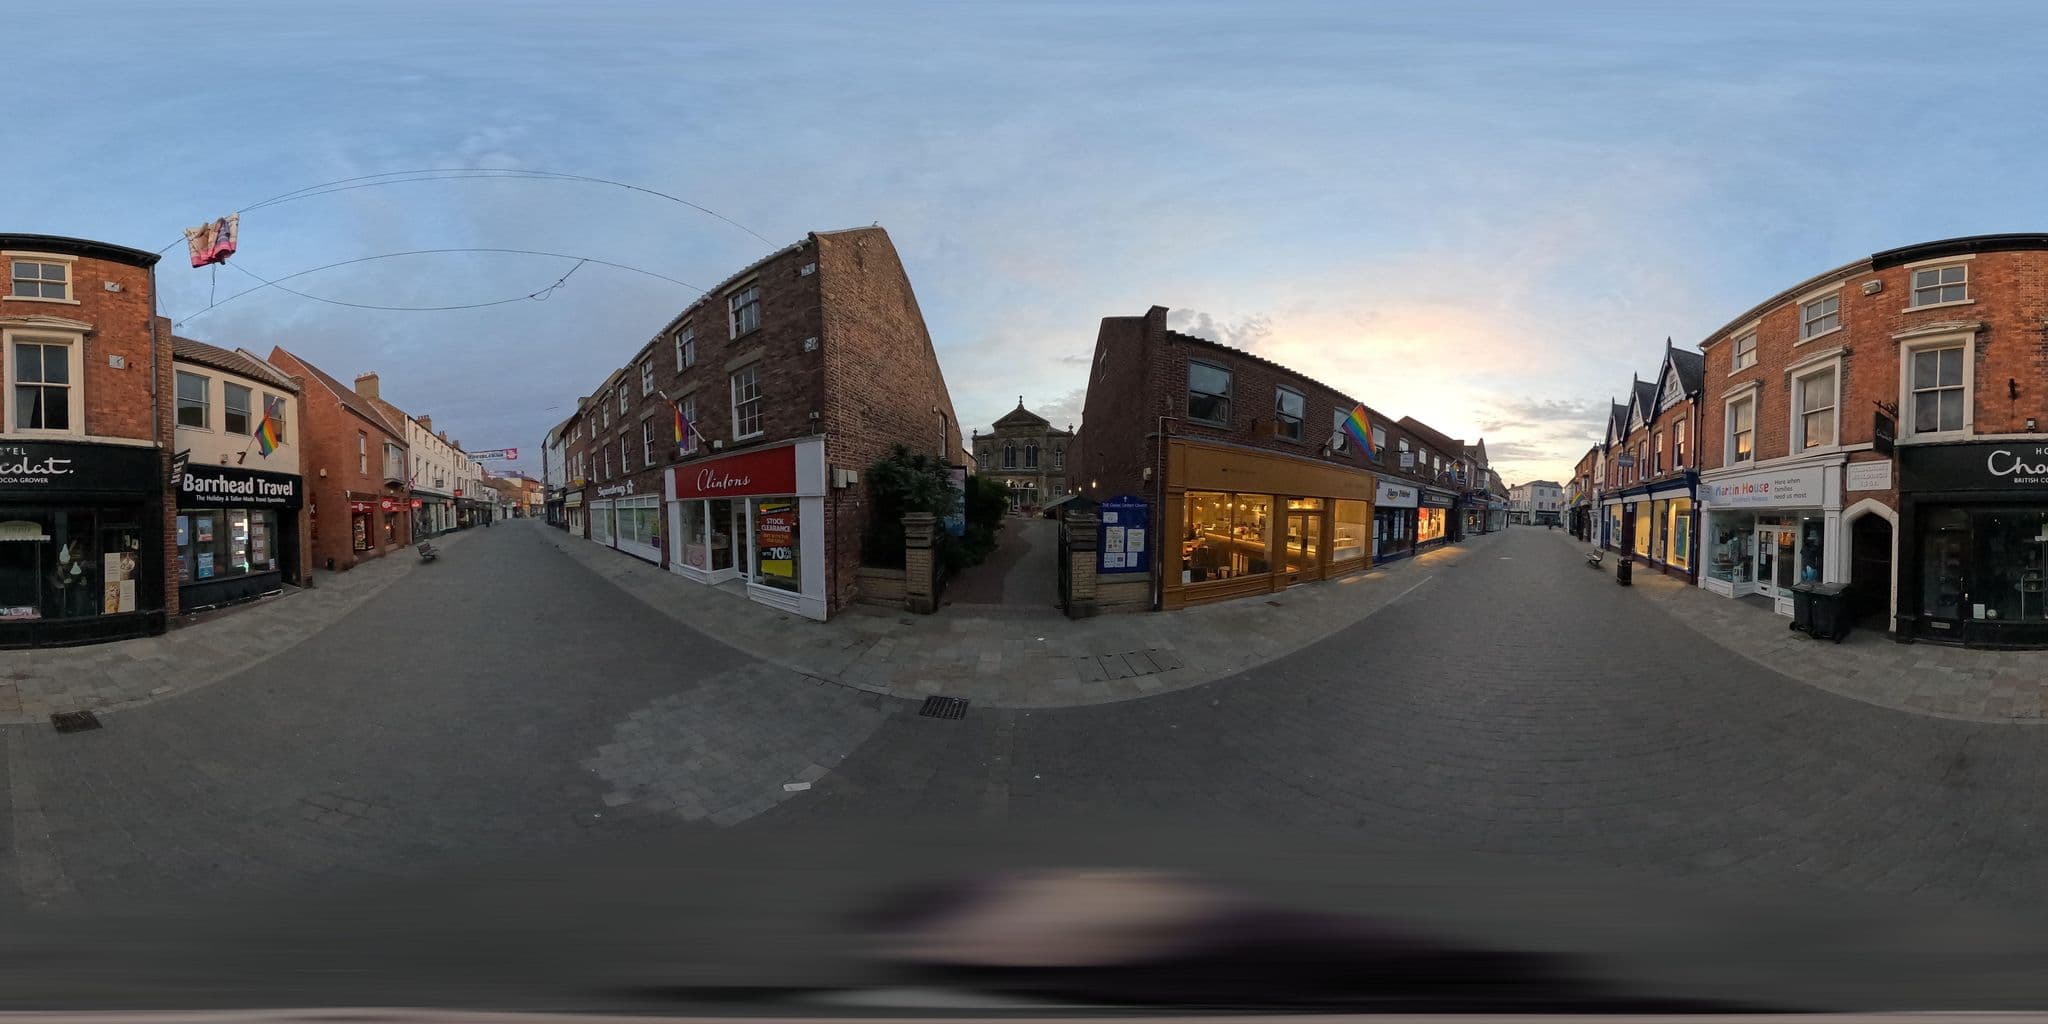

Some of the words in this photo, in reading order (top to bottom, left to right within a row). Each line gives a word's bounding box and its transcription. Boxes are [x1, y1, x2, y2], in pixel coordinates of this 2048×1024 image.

[1987, 450, 2048, 476] Cho
[183, 473, 254, 494] Barrhead
[257, 478, 293, 496] Travel
[697, 468, 751, 492] Clintons
[1742, 481, 1769, 495] House
[761, 524, 792, 533] CLEARANCE
[766, 517, 785, 525] STOCK
